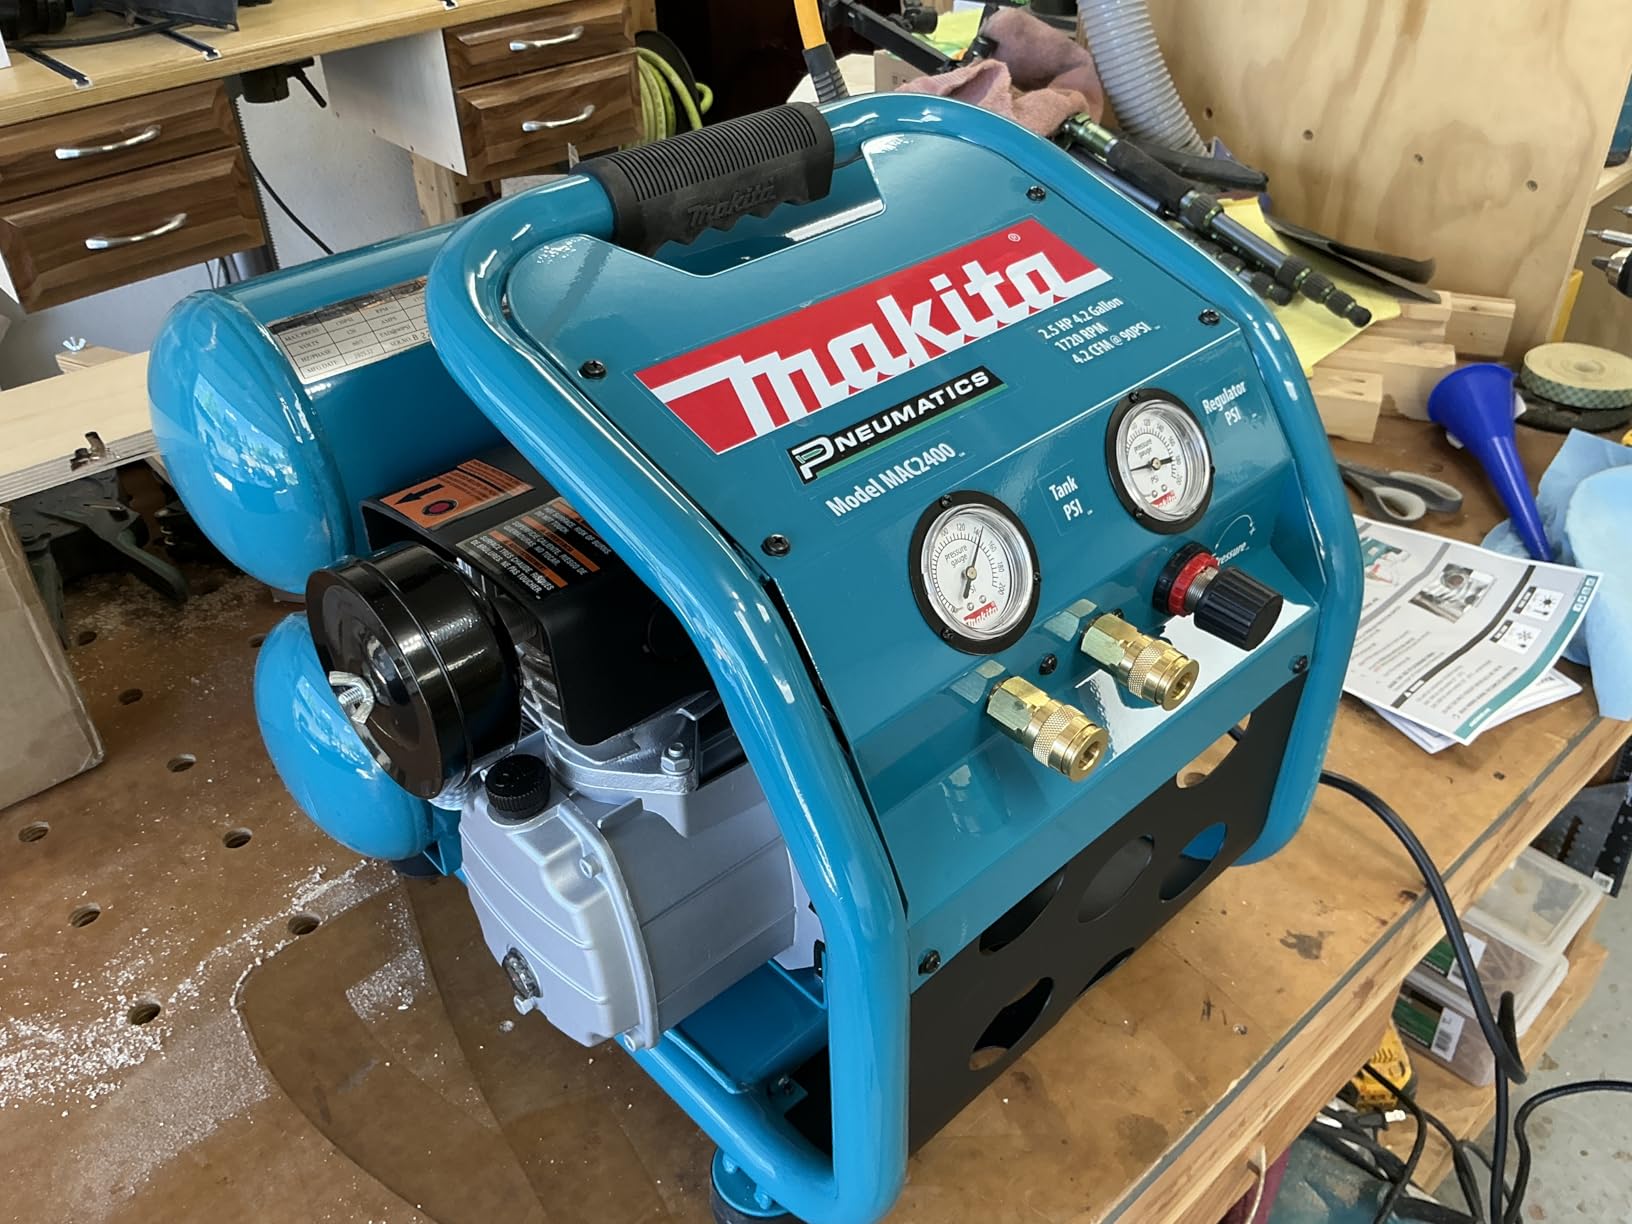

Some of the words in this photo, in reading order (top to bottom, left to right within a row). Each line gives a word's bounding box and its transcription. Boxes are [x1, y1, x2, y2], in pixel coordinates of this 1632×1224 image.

[1038, 325, 1060, 339] 2.5
[1055, 318, 1072, 331] HP
[1072, 311, 1093, 323] 4.2
[1087, 298, 1124, 316] Gallon
[1054, 336, 1085, 351] 1720
[1081, 321, 1109, 341] RPM
[651, 252, 1113, 437] makita
[1071, 350, 1094, 364] 4.2
[1087, 339, 1115, 356] CFM
[1109, 334, 1123, 346] @
[1119, 320, 1153, 342] 90PSI
[1202, 381, 1247, 415] Regulator
[791, 370, 990, 480] PNEUMATICS
[1224, 409, 1242, 426] PSI
[825, 477, 886, 517] Model
[882, 442, 956, 490] MAC2400
[1048, 475, 1079, 501] Tank
[1062, 498, 1084, 521] PSI
